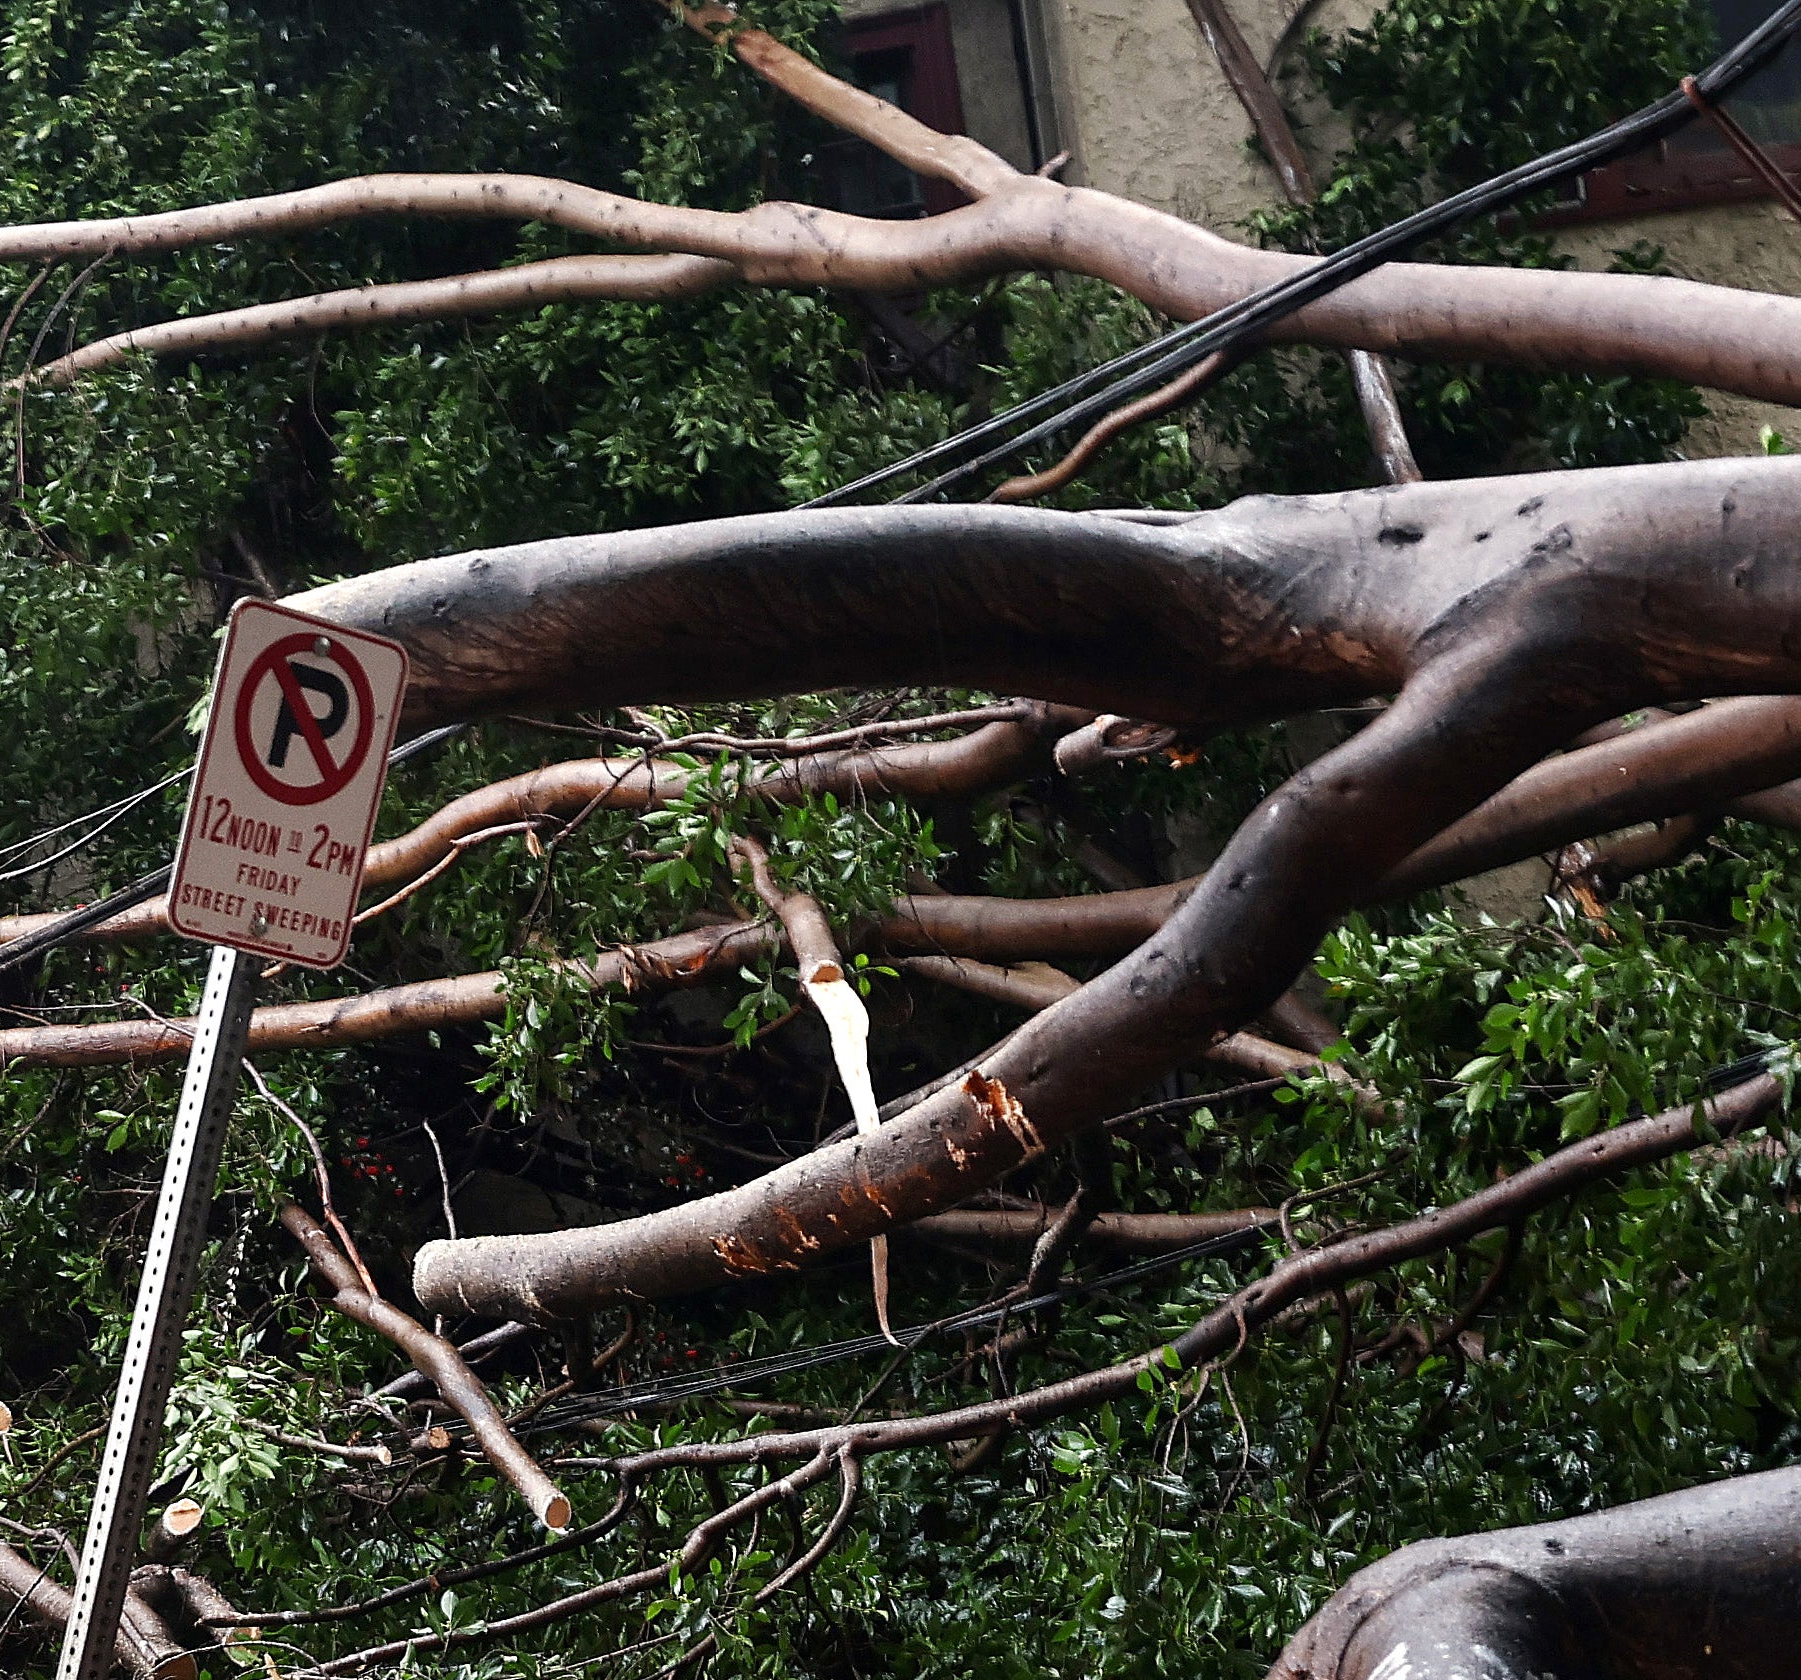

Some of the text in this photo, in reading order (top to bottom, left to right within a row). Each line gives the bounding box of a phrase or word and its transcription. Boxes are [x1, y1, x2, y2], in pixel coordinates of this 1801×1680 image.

[306, 823, 356, 877] 2PM
[236, 863, 302, 897] FRIDAY
[181, 883, 247, 918] STREET
[253, 901, 343, 941] SWEEPING
